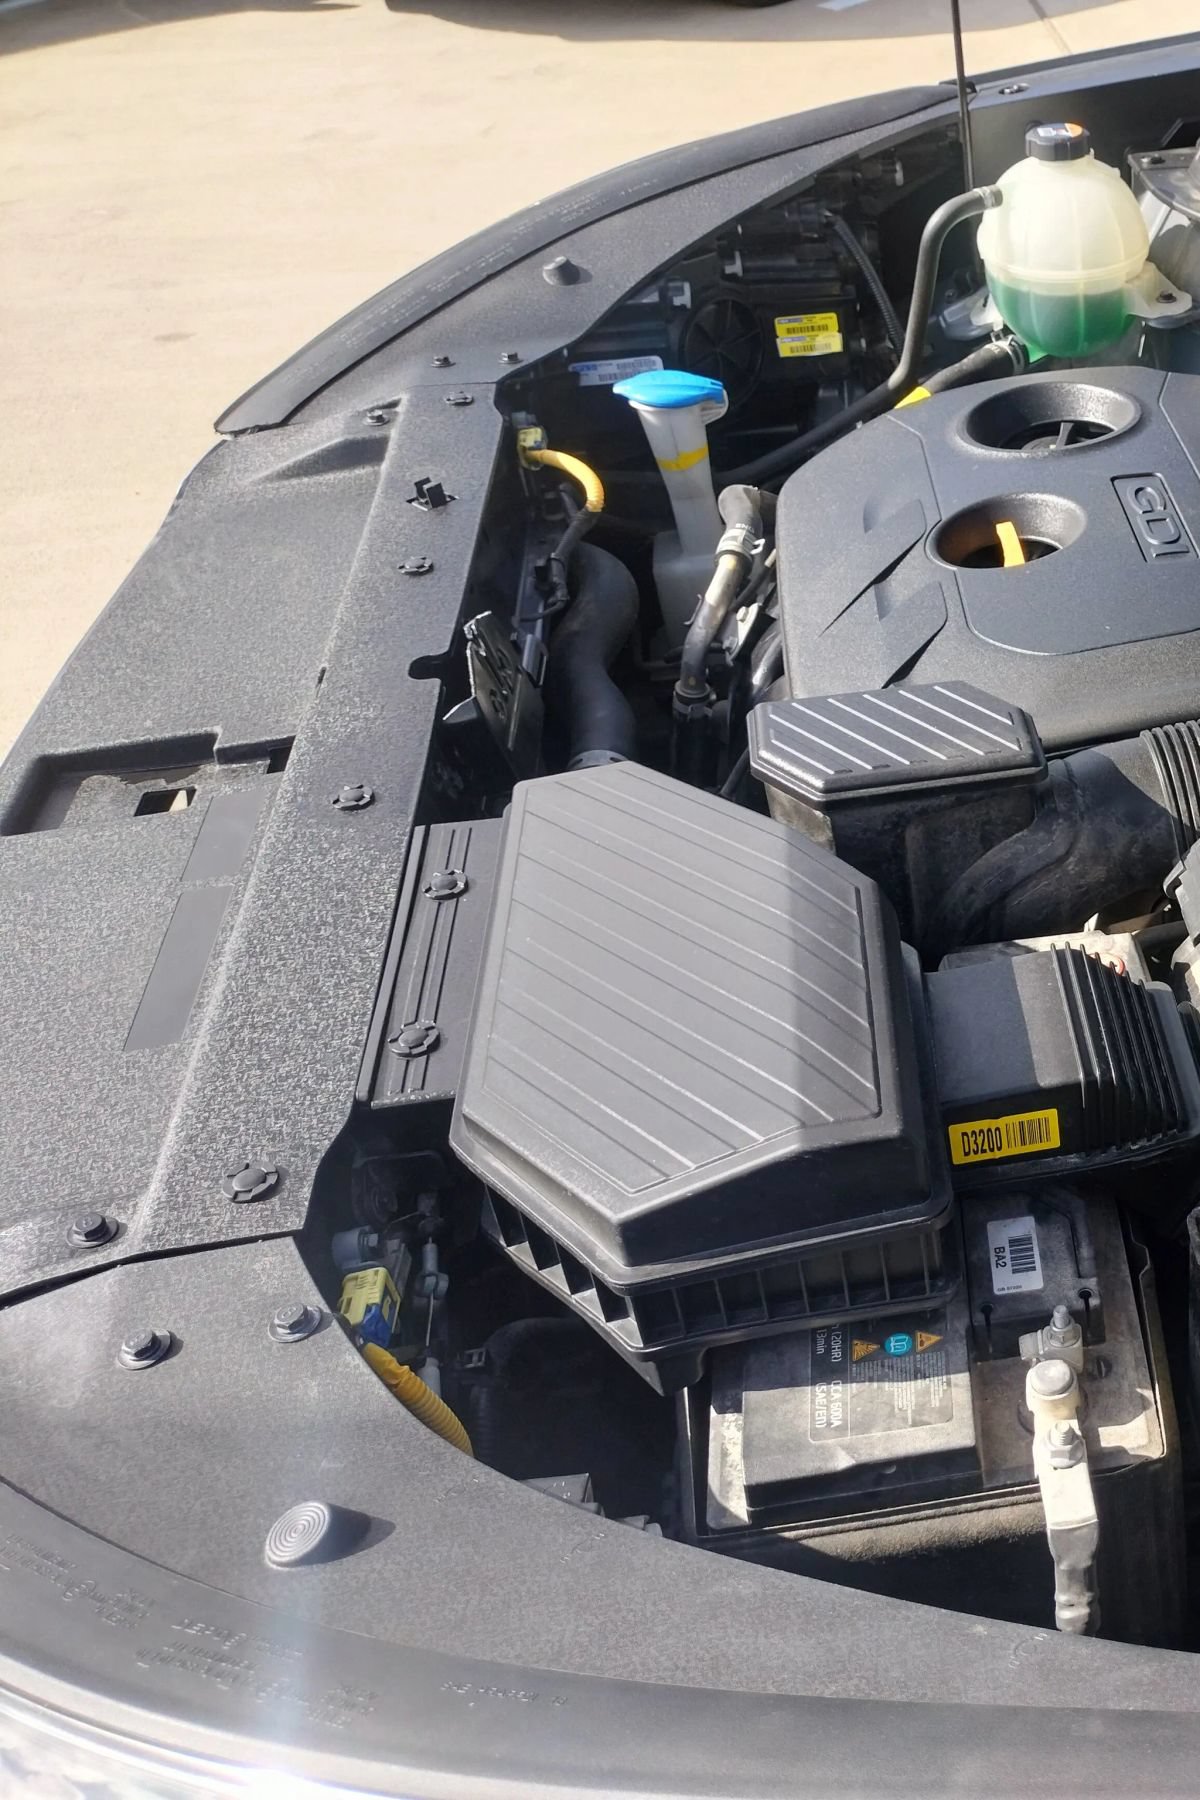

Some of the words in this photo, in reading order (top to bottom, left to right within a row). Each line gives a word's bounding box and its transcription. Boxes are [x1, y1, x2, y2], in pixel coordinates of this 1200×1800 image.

[1127, 486, 1190, 558] GDI
[961, 1127, 1003, 1157] D3200
[993, 1246, 1007, 1269] BA2
[831, 1331, 843, 1362] (20HR)
[830, 1400, 843, 1428] 600A
